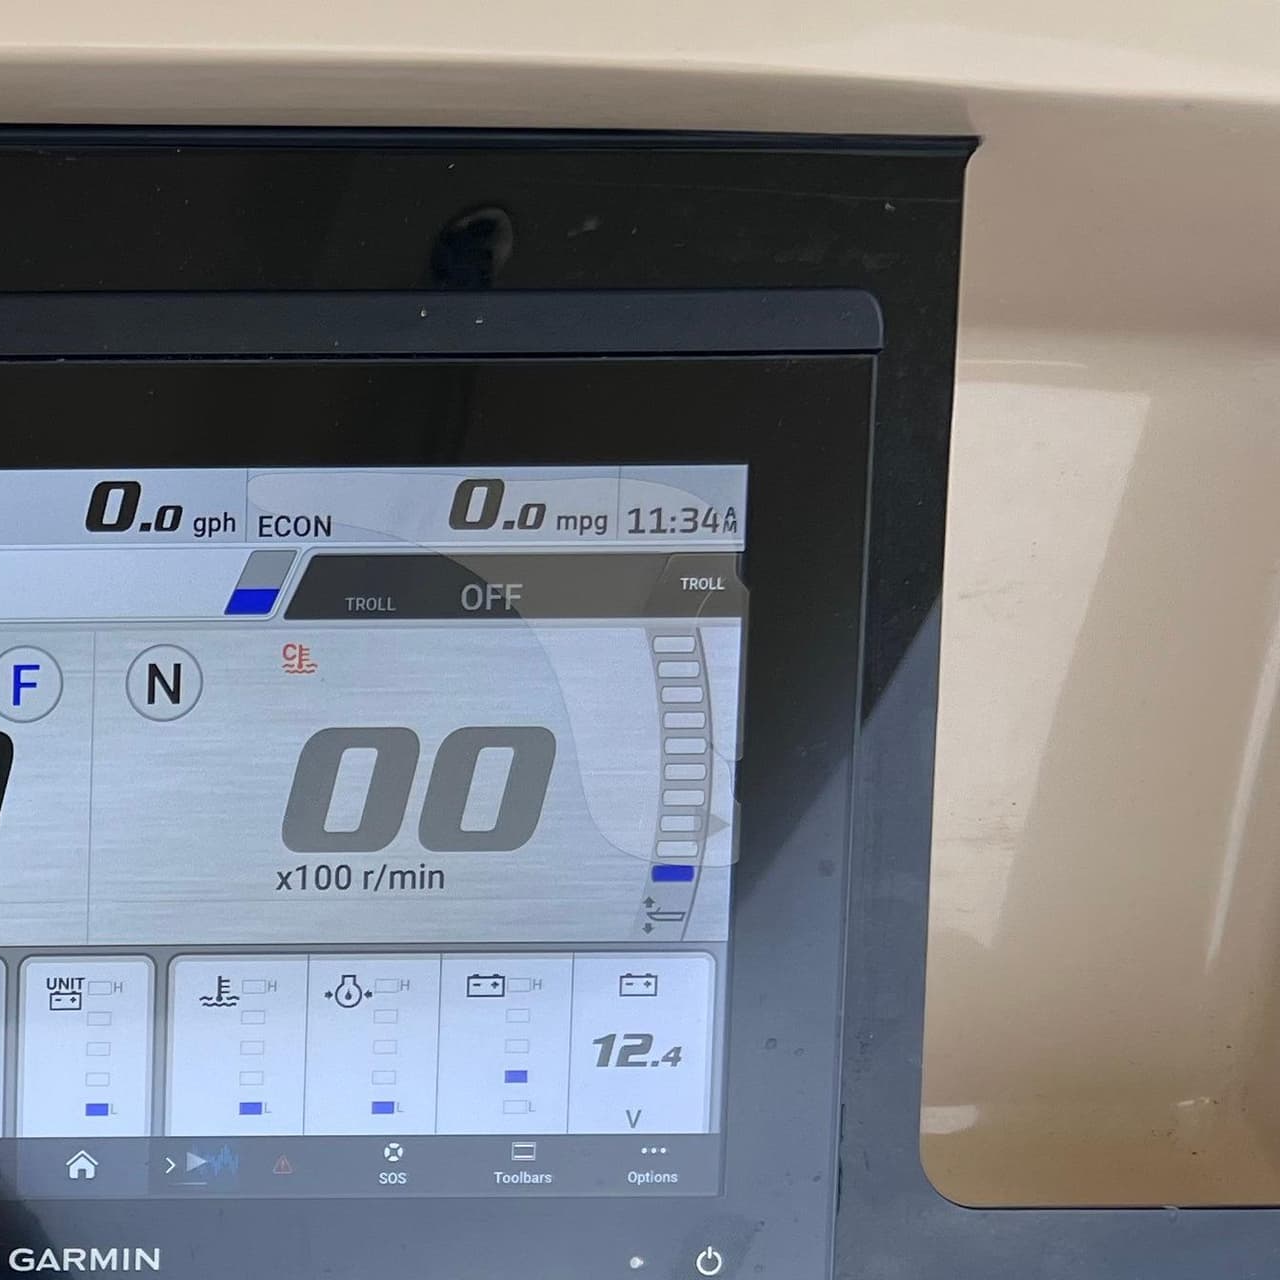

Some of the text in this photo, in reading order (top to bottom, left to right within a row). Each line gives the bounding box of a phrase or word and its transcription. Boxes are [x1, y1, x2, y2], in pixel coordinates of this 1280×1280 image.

[85, 481, 236, 540] 0.0 gph
[448, 478, 608, 536] 0.0 mpg
[258, 515, 332, 538] ECON
[627, 507, 720, 534] 11:34
[680, 577, 726, 590] TROLL
[345, 596, 396, 611] TROLL
[461, 583, 523, 611] OFF
[13, 664, 40, 706] F
[148, 663, 182, 705] N
[281, 725, 557, 853] 00
[276, 863, 446, 892] x100 r/min
[46, 977, 86, 991] UNIT
[591, 1033, 683, 1068] 12.4
[626, 1109, 642, 1129] V
[379, 1171, 406, 1184] SOS
[494, 1170, 552, 1184] Toolbars
[627, 1170, 678, 1188] Options
[8, 1247, 160, 1272] GARMIN
